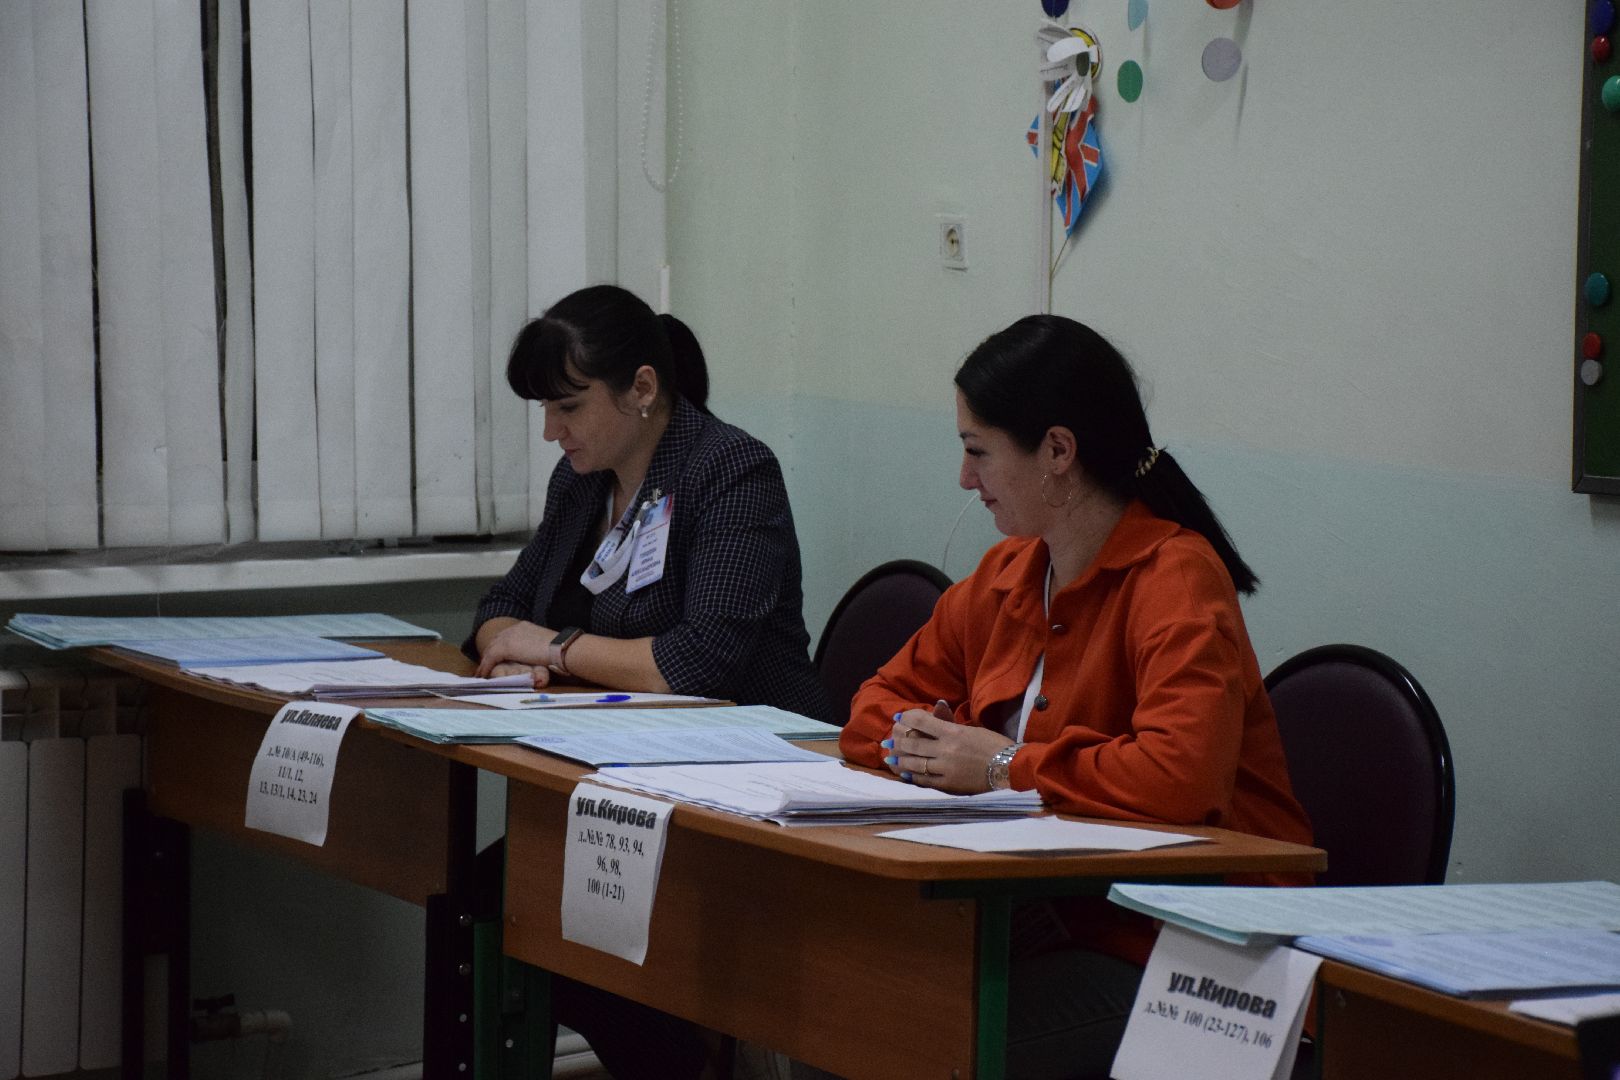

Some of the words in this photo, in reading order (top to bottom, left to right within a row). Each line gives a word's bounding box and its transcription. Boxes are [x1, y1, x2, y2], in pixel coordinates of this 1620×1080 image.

[309, 791, 317, 805] 24
[576, 796, 657, 830] ул.Кирова
[605, 834, 616, 851] 78,
[619, 836, 630, 854] 93,
[633, 840, 644, 856] 94,
[596, 855, 608, 873] 96,
[610, 858, 621, 876] 98,
[587, 878, 601, 894] 100
[602, 882, 625, 903] (1-21)
[1167, 971, 1277, 1019] ул.Кирова
[1184, 1009, 1203, 1026] 100
[1253, 1030, 1272, 1049] 106
